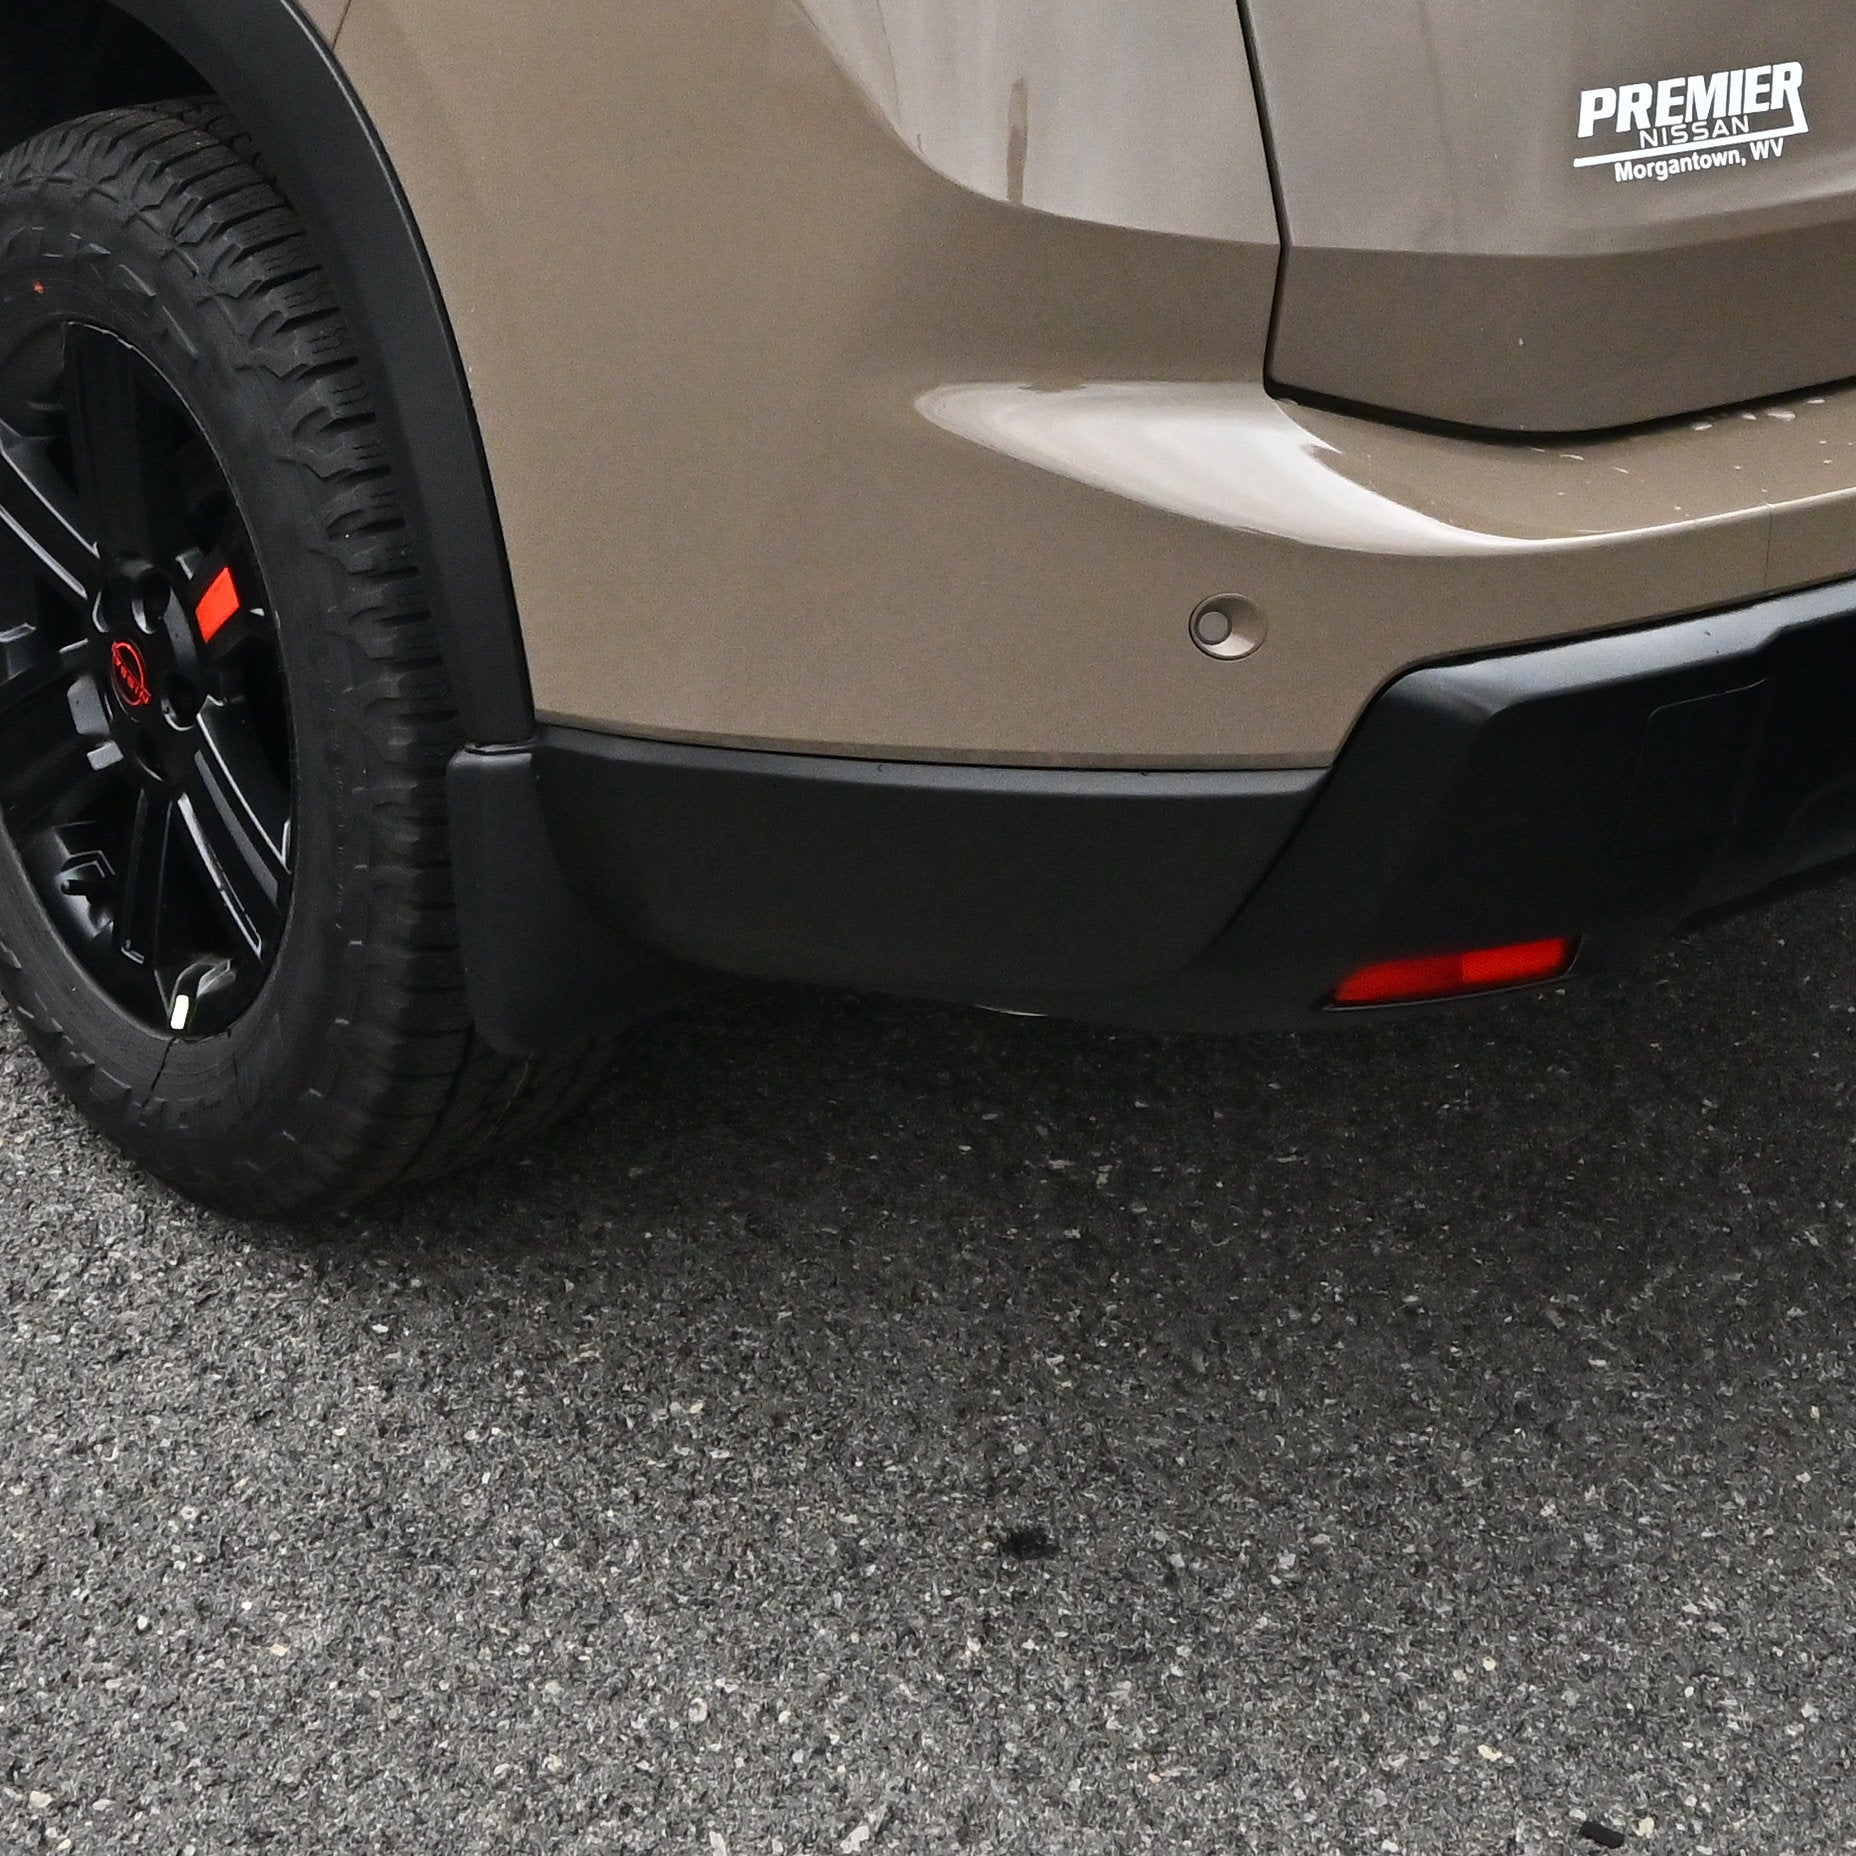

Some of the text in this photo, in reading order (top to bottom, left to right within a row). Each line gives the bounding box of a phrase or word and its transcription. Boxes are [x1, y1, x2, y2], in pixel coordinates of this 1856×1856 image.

[1577, 61, 1808, 139] PREMIER
[1639, 114, 1750, 149] NISSAN
[1614, 138, 1785, 183] Morgantown, WV
